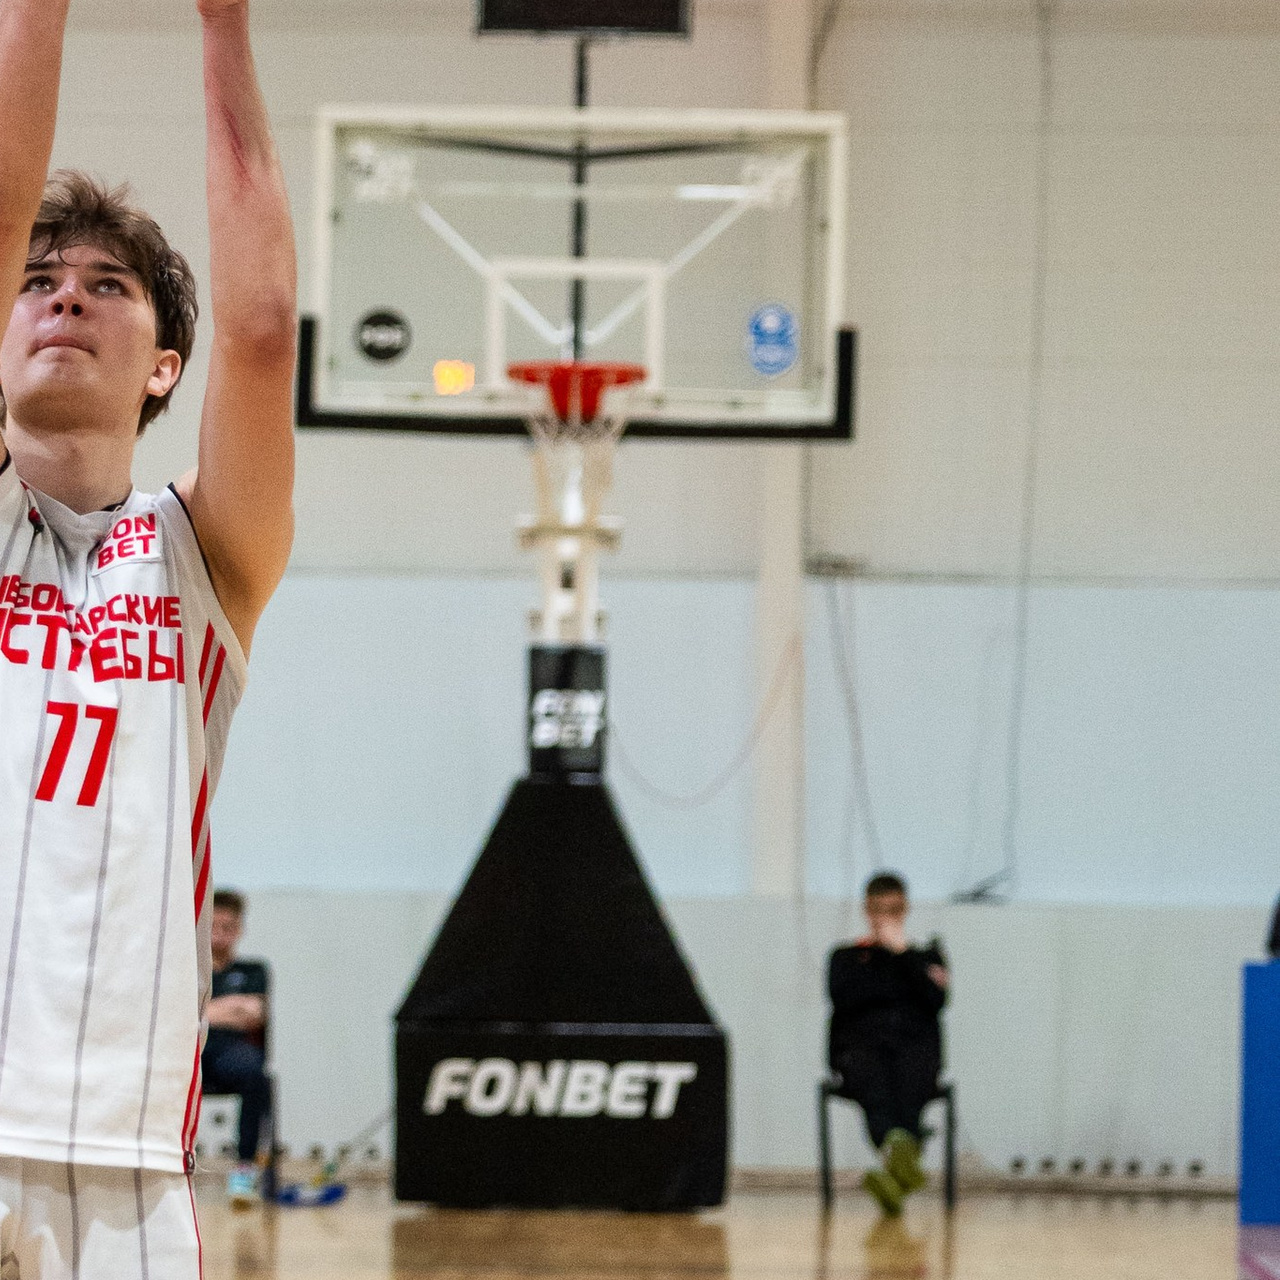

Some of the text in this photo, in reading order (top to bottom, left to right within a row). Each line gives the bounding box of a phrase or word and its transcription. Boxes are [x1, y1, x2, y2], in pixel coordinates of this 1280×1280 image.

[97, 533, 156, 570] BET
[106, 513, 156, 541] ON
[35, 701, 118, 807] 77
[423, 1058, 697, 1119] FONBET
